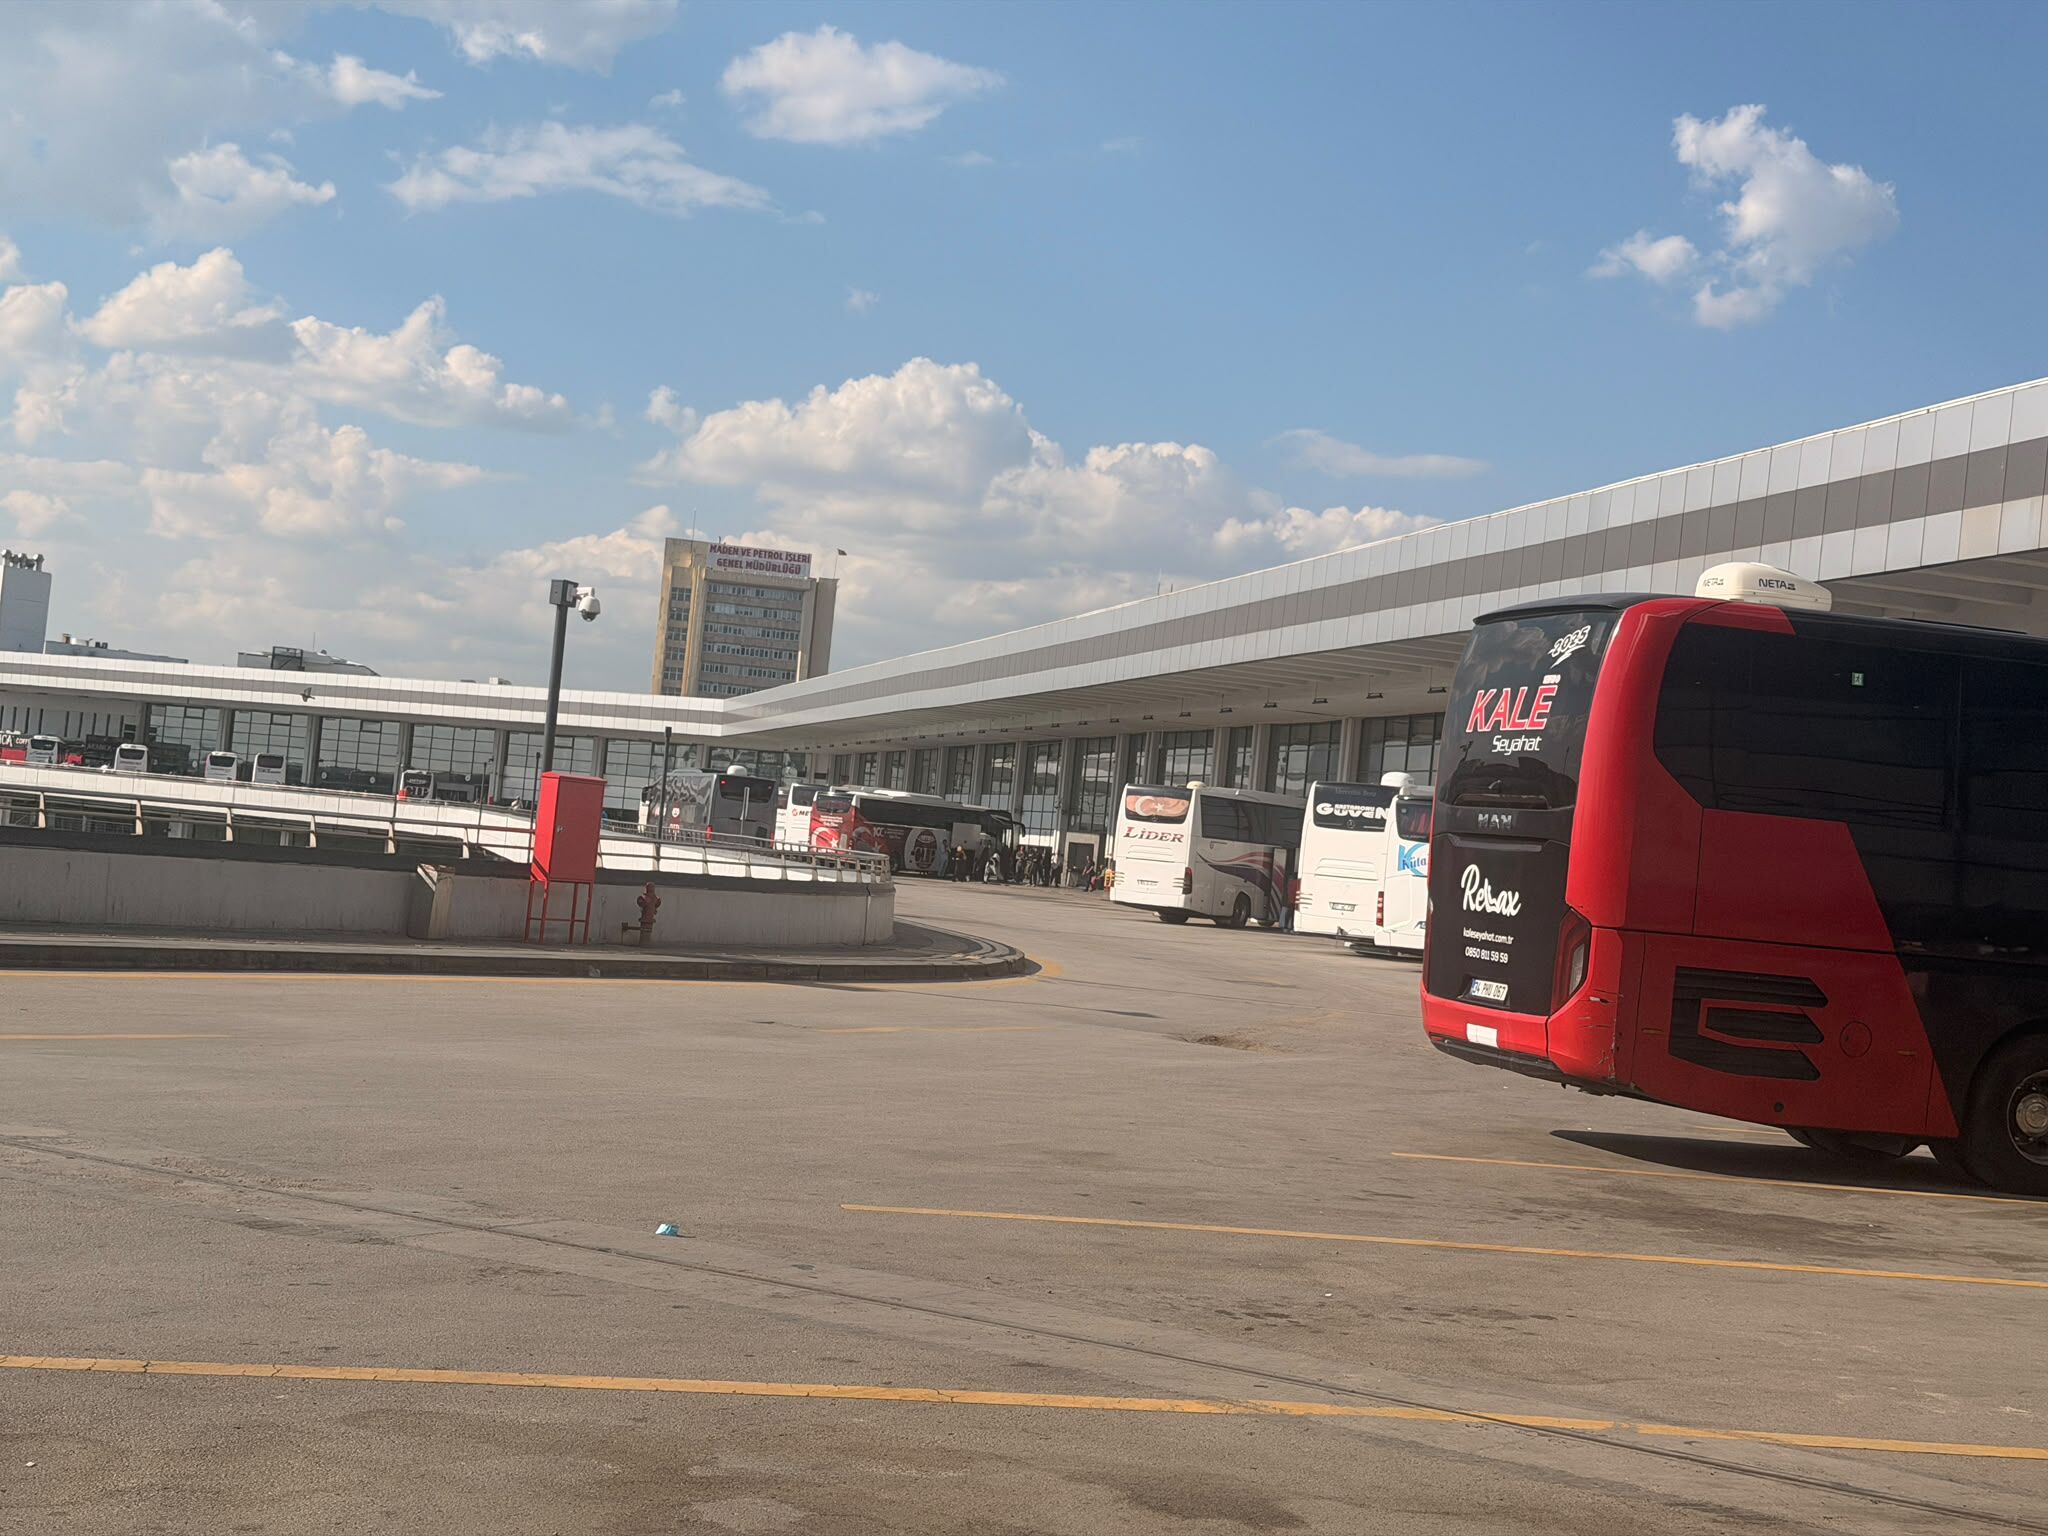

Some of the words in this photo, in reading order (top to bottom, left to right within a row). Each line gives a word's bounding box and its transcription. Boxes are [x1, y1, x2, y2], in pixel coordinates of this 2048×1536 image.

[709, 543, 739, 555] MADEN
[741, 548, 752, 557] VE
[753, 549, 783, 560] PETROL
[717, 558, 743, 569] GENEL
[745, 560, 801, 575] MÜDÜRLÜĞÜ
[1547, 625, 1591, 657] 2025
[1465, 685, 1558, 732] KALE
[1491, 735, 1542, 755] Seyahat
[1477, 813, 1512, 829] MAN
[1463, 927, 1514, 944] kaleseyahat.com.tr
[1465, 946, 1480, 958] 0850
[1481, 949, 1490, 961] 811
[1490, 950, 1499, 962] 59
[1500, 952, 1509, 964] 59
